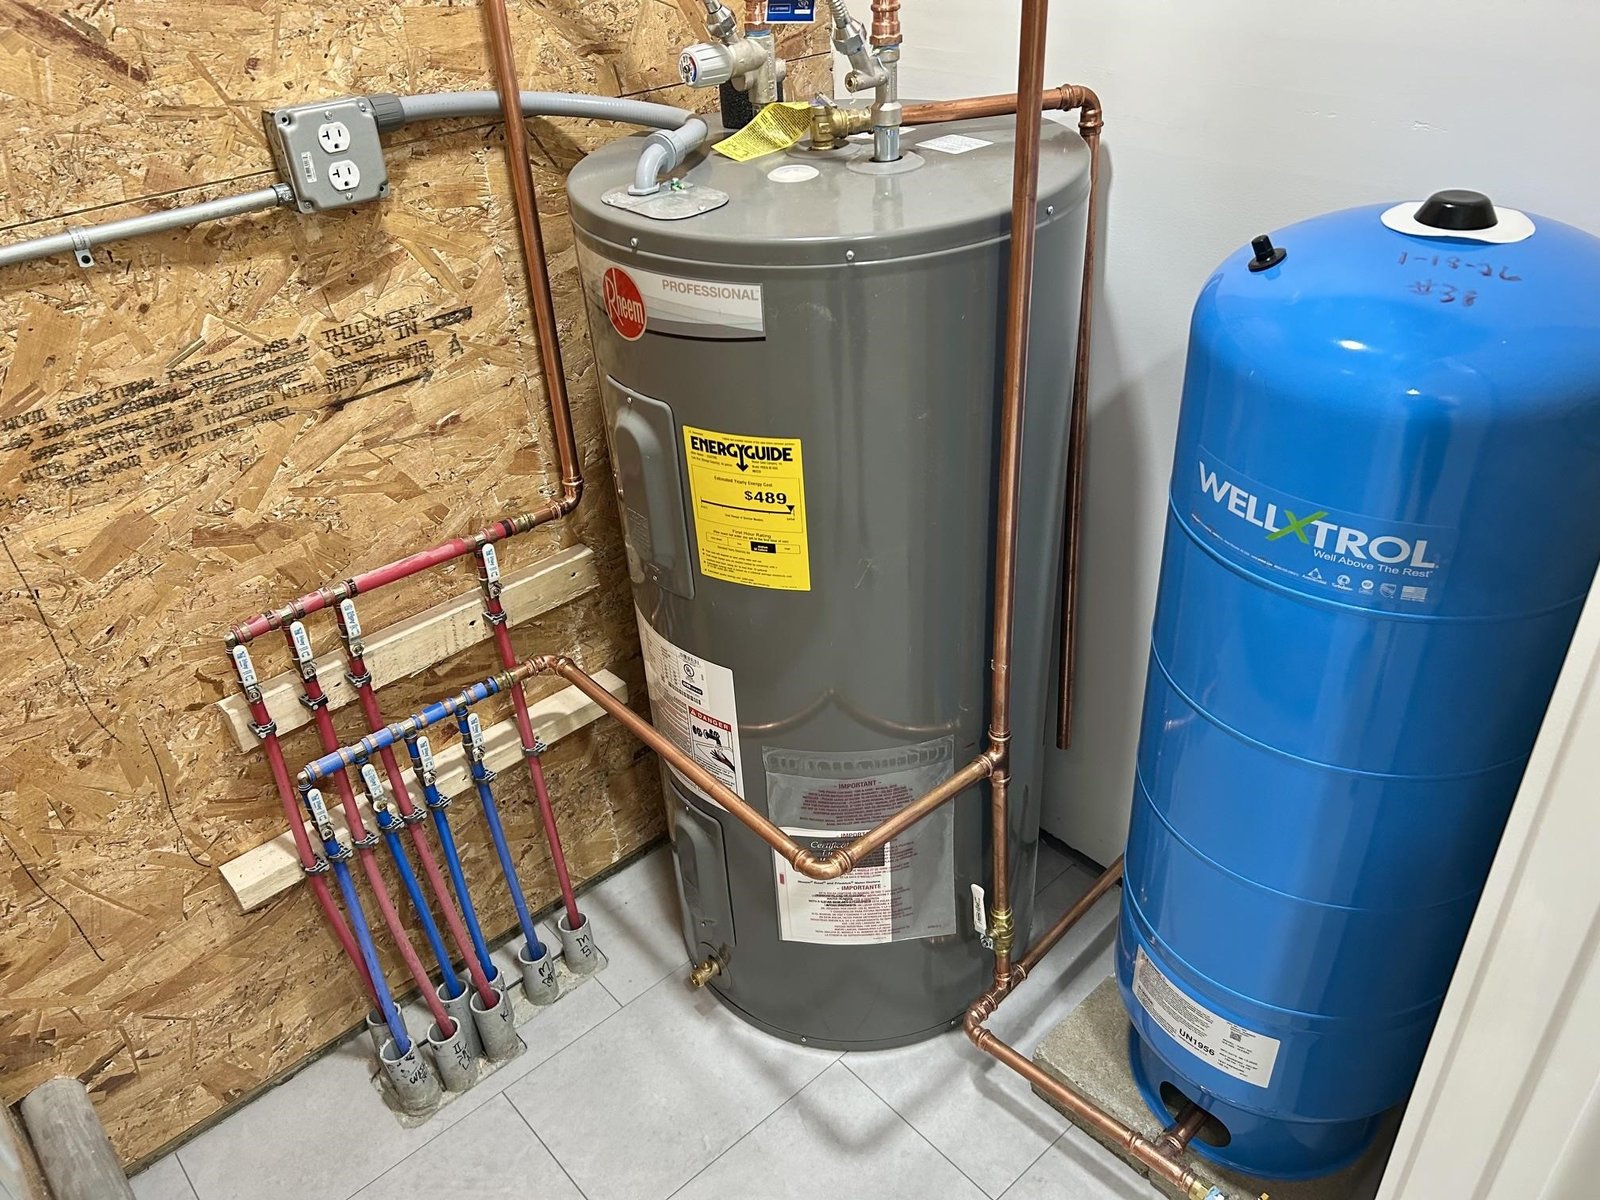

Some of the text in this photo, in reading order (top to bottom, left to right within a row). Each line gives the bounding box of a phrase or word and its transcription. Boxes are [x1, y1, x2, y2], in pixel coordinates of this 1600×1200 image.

[604, 268, 644, 326] Rheem
[662, 279, 759, 301] PROFESSIONAL
[393, 321, 418, 341] IN
[244, 338, 290, 359] CLASS
[203, 395, 274, 425] INCLUDED
[744, 491, 787, 505] $489
[1313, 549, 1336, 561] Well
[1338, 557, 1374, 571] Above
[1377, 564, 1399, 575] The
[697, 711, 730, 731] DANGER
[838, 780, 877, 789] IMPORTANT
[1178, 1028, 1215, 1056] UN1956
